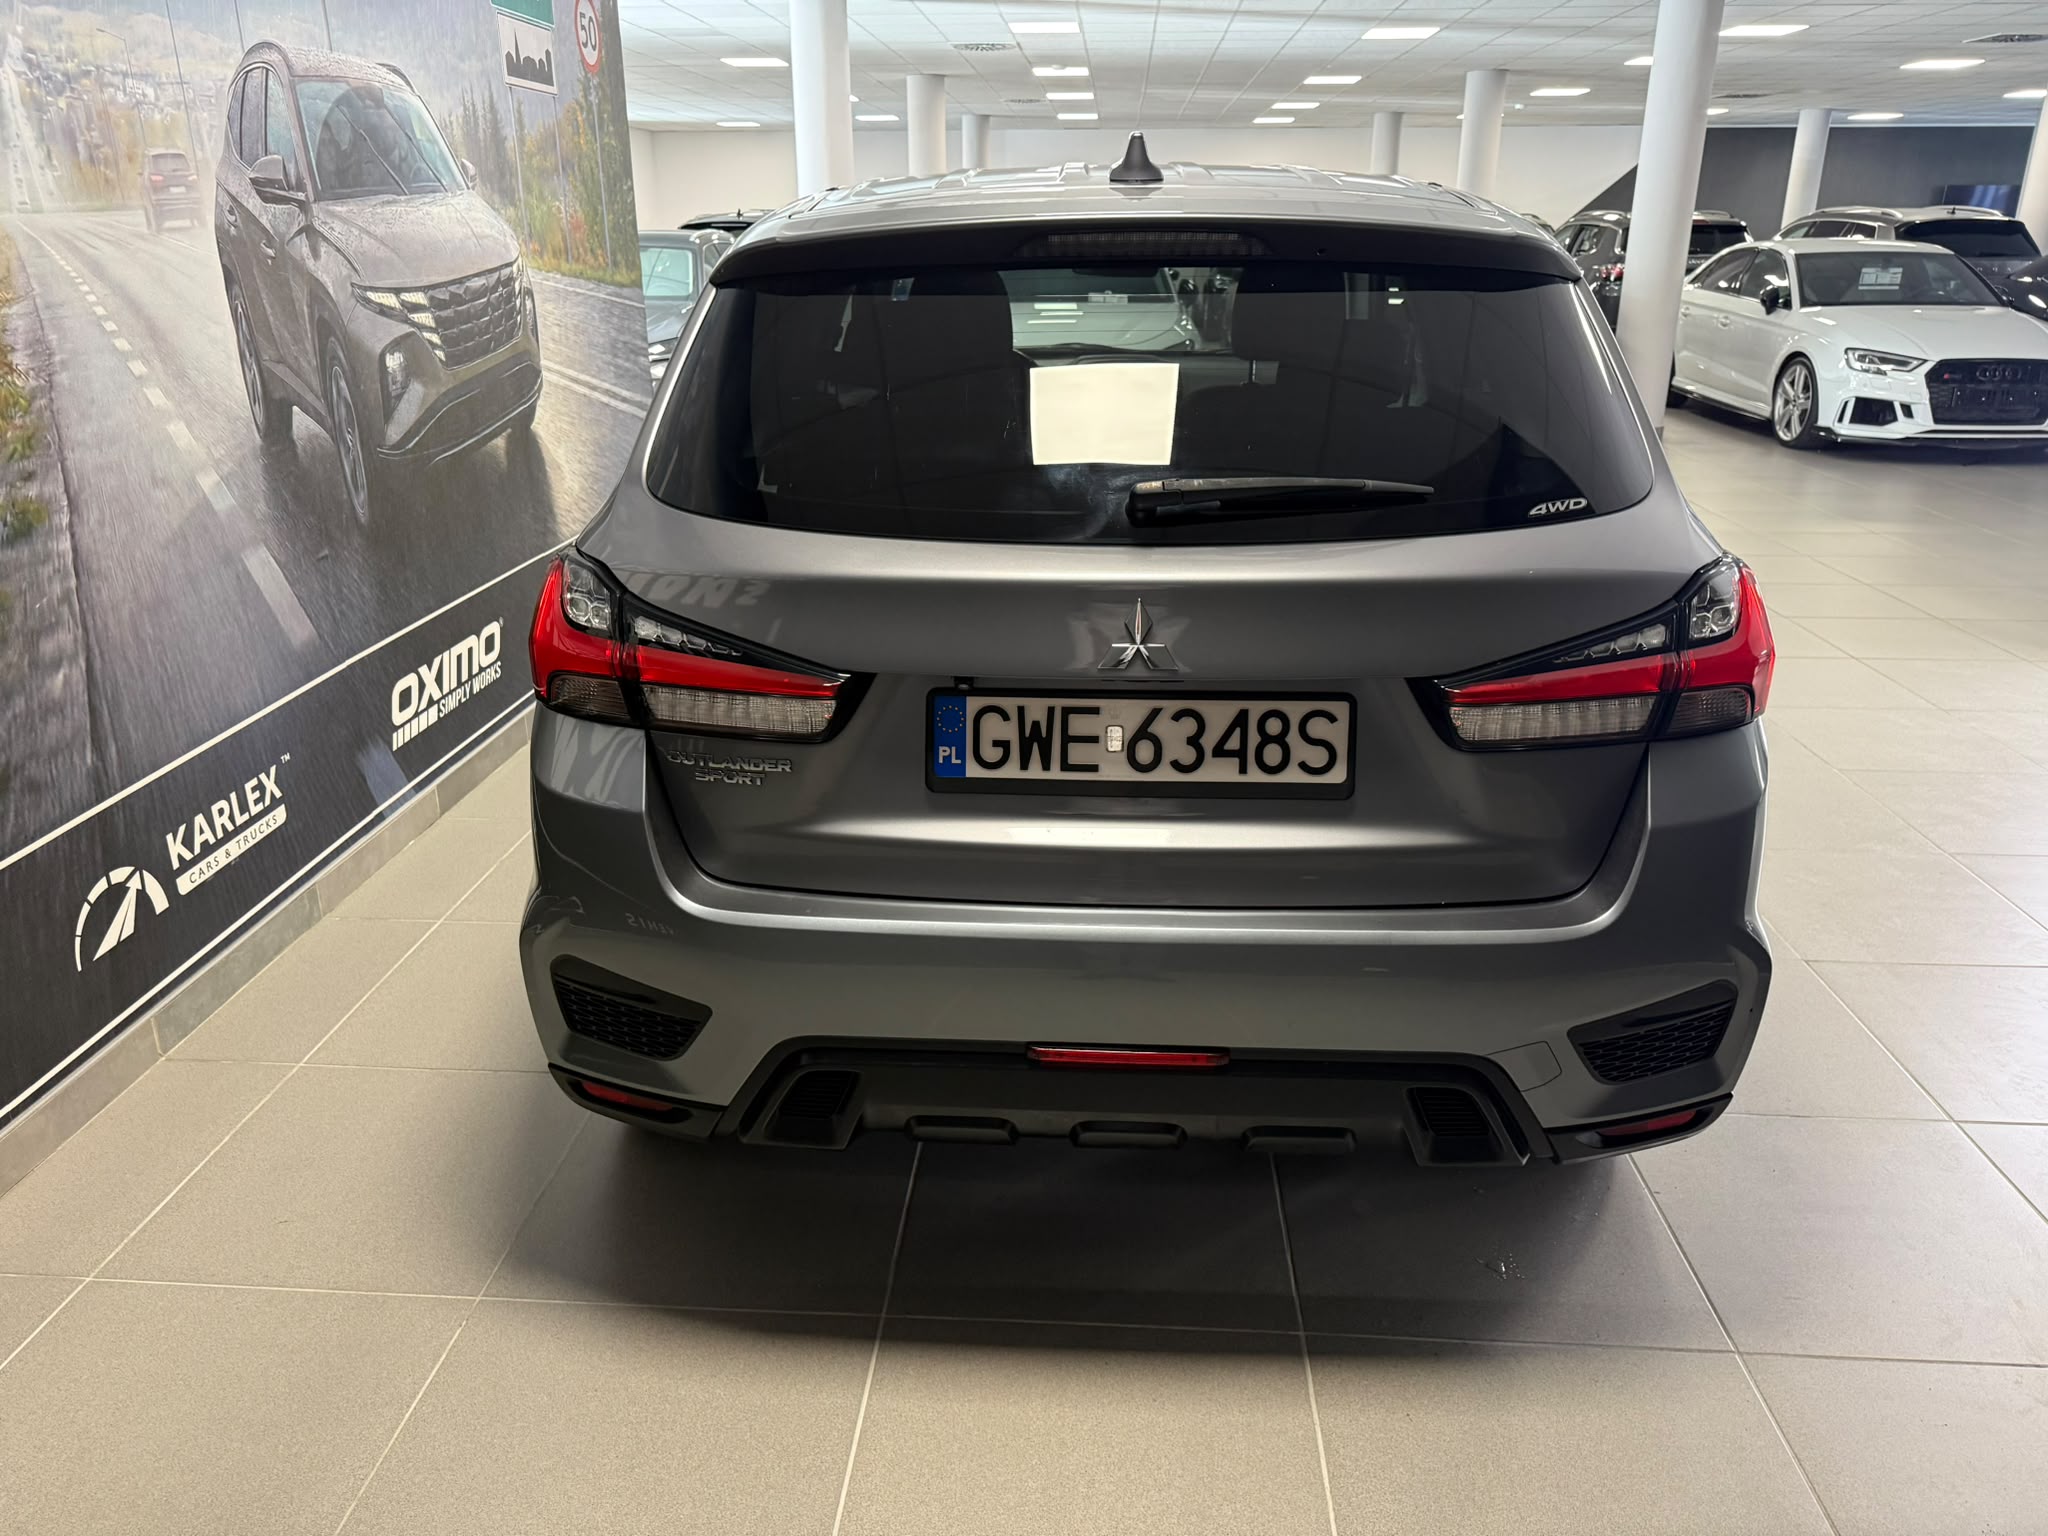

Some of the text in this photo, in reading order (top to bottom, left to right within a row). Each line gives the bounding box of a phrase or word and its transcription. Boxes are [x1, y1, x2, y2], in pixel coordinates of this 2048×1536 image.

[580, 11, 597, 52] 50
[1528, 498, 1588, 516] 4WD
[391, 621, 501, 726] OXIMO
[439, 660, 502, 718] SIMPLY WORKS
[666, 750, 793, 773] OUTLANDER
[938, 746, 962, 764] PL
[972, 704, 1339, 776] GWE 6348S
[695, 769, 766, 786] SPORT
[165, 764, 283, 871] KARLEX
[188, 814, 278, 884] CARS & TRUCKS
